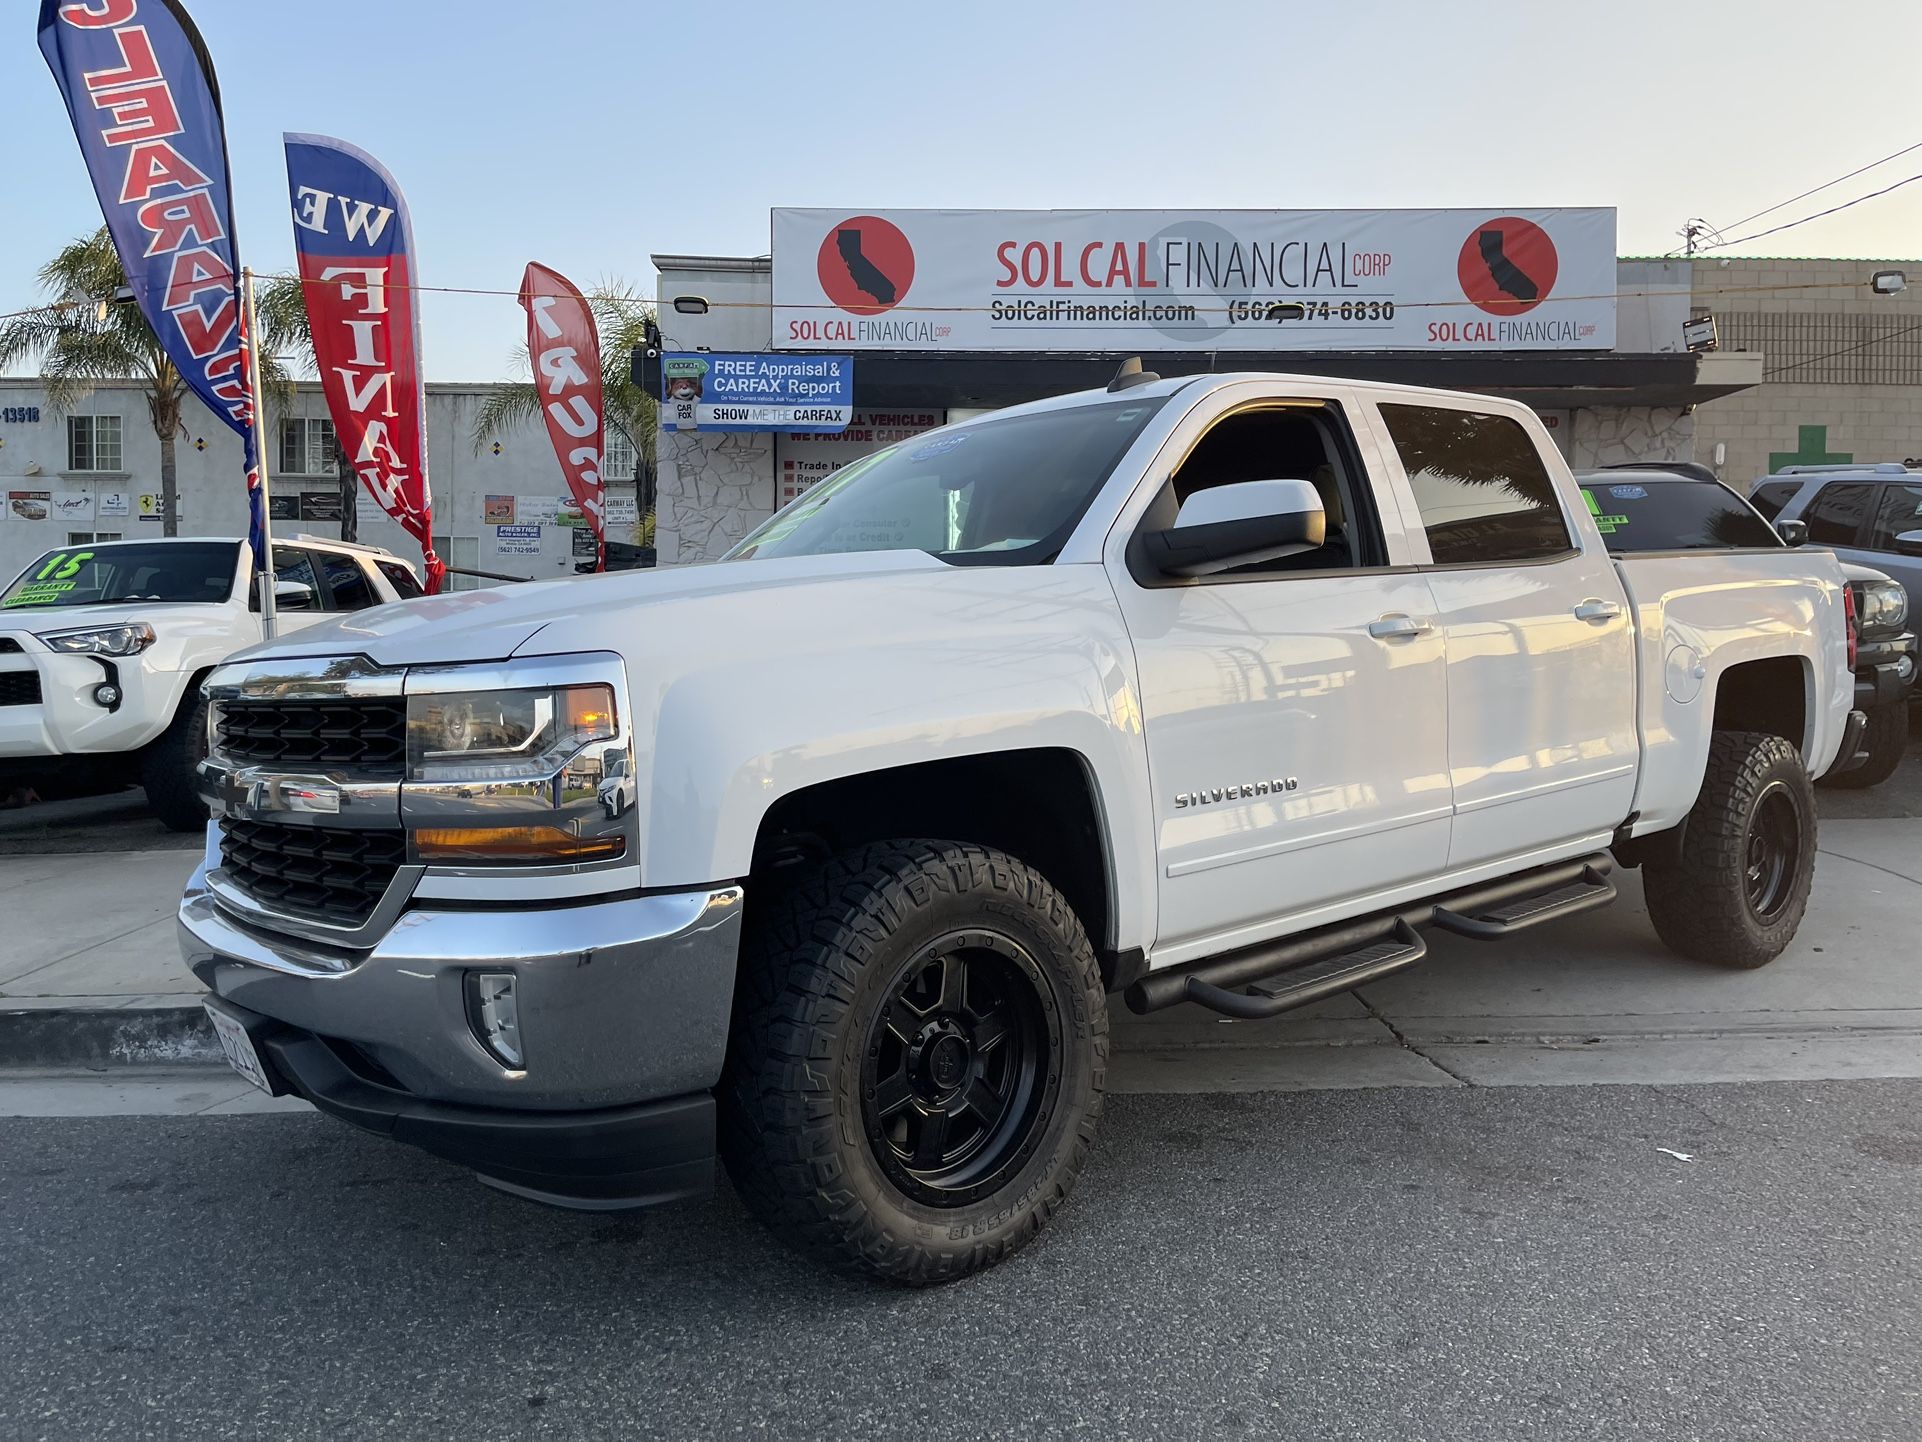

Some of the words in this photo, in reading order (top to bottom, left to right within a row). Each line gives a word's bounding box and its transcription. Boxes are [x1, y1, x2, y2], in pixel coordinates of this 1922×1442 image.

[1352, 253, 1391, 277] CORP
[991, 300, 1196, 322] SolCalFinancial.com
[714, 360, 755, 375] FREE
[759, 362, 827, 380] Appraisal
[830, 362, 841, 377] &
[788, 379, 841, 397] Report
[677, 404, 692, 412] CAR
[678, 412, 692, 420] FOX
[714, 408, 749, 420] SHOW
[752, 409, 768, 420] ME
[771, 409, 791, 421] THE
[793, 409, 842, 421] CARFAX
[869, 414, 935, 426] VEHICLES
[814, 430, 873, 442] PROVIDE
[877, 430, 924, 442] CARF
[797, 461, 828, 470] Trade
[37, 552, 95, 580] 15
[21, 583, 72, 594] WARRANTY
[5, 595, 57, 605] CLEARANCE
[1175, 776, 1298, 809] SILVERADO
